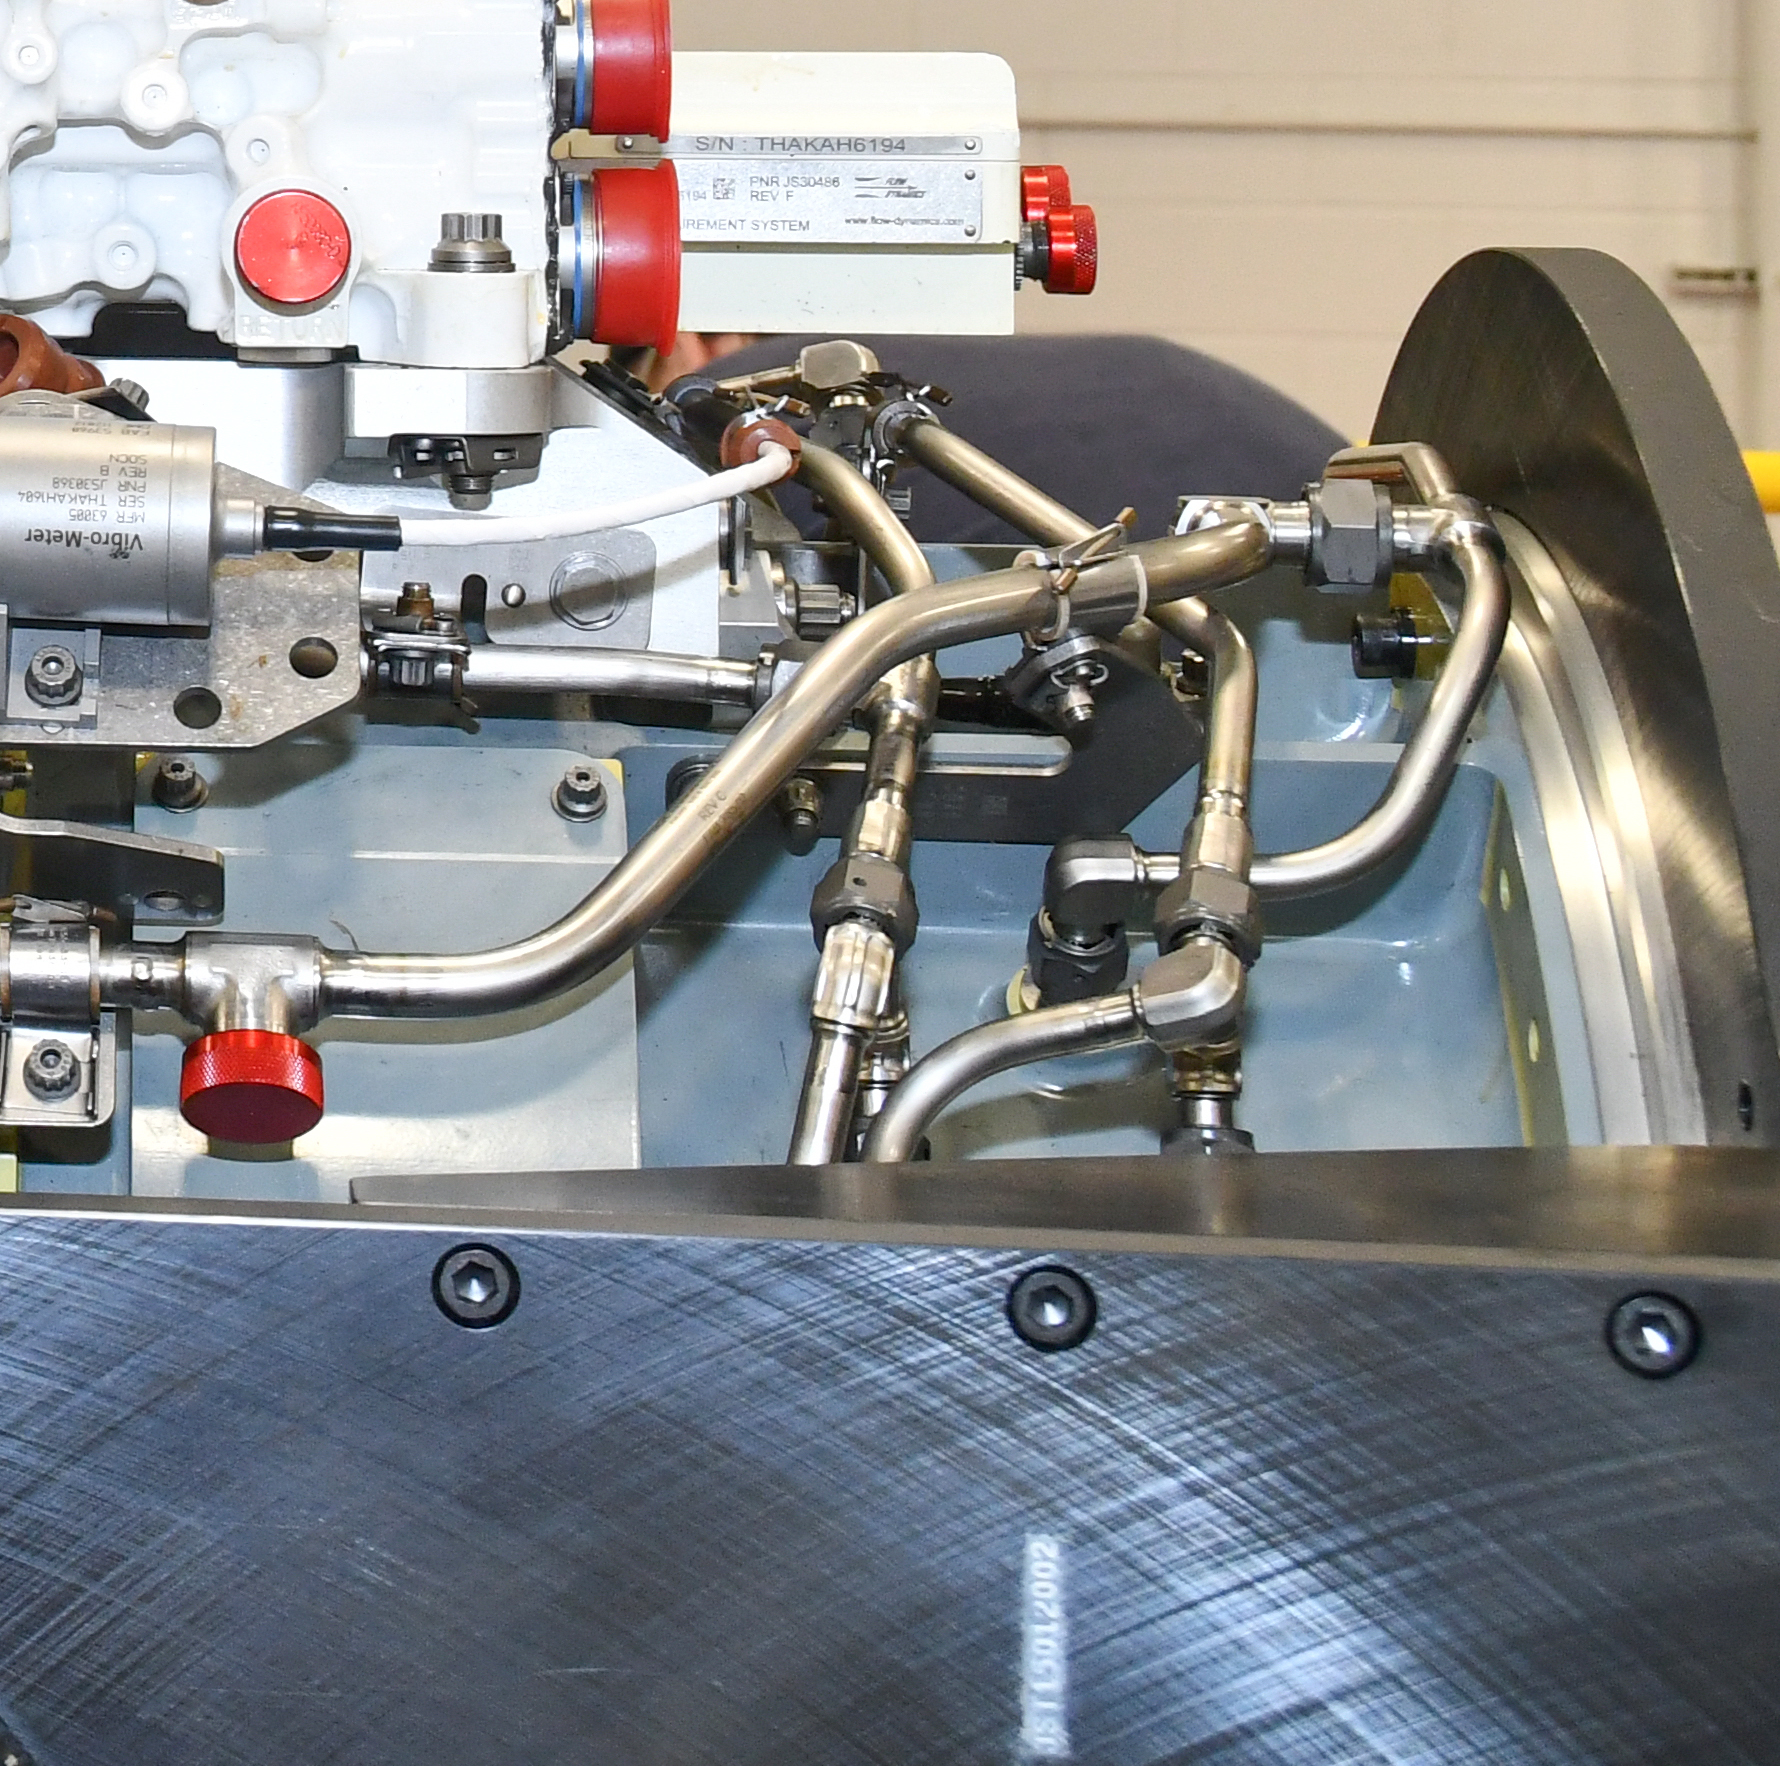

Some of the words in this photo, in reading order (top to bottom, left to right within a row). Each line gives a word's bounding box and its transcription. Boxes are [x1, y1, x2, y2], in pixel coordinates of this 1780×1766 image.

[696, 136, 734, 151] S/N
[755, 136, 906, 152] THAKAH6194
[750, 176, 780, 187] PNR
[783, 176, 840, 188] JS30486
[751, 190, 779, 201] REV
[786, 190, 794, 201] F
[751, 220, 810, 231] SYSTEM
[100, 465, 110, 476] B
[118, 467, 147, 479] REV
[117, 481, 147, 493] PNR
[118, 496, 146, 508] SER
[68, 509, 108, 522] 63005
[116, 512, 146, 524] MFR
[24, 528, 144, 551] Vibro-Meter
